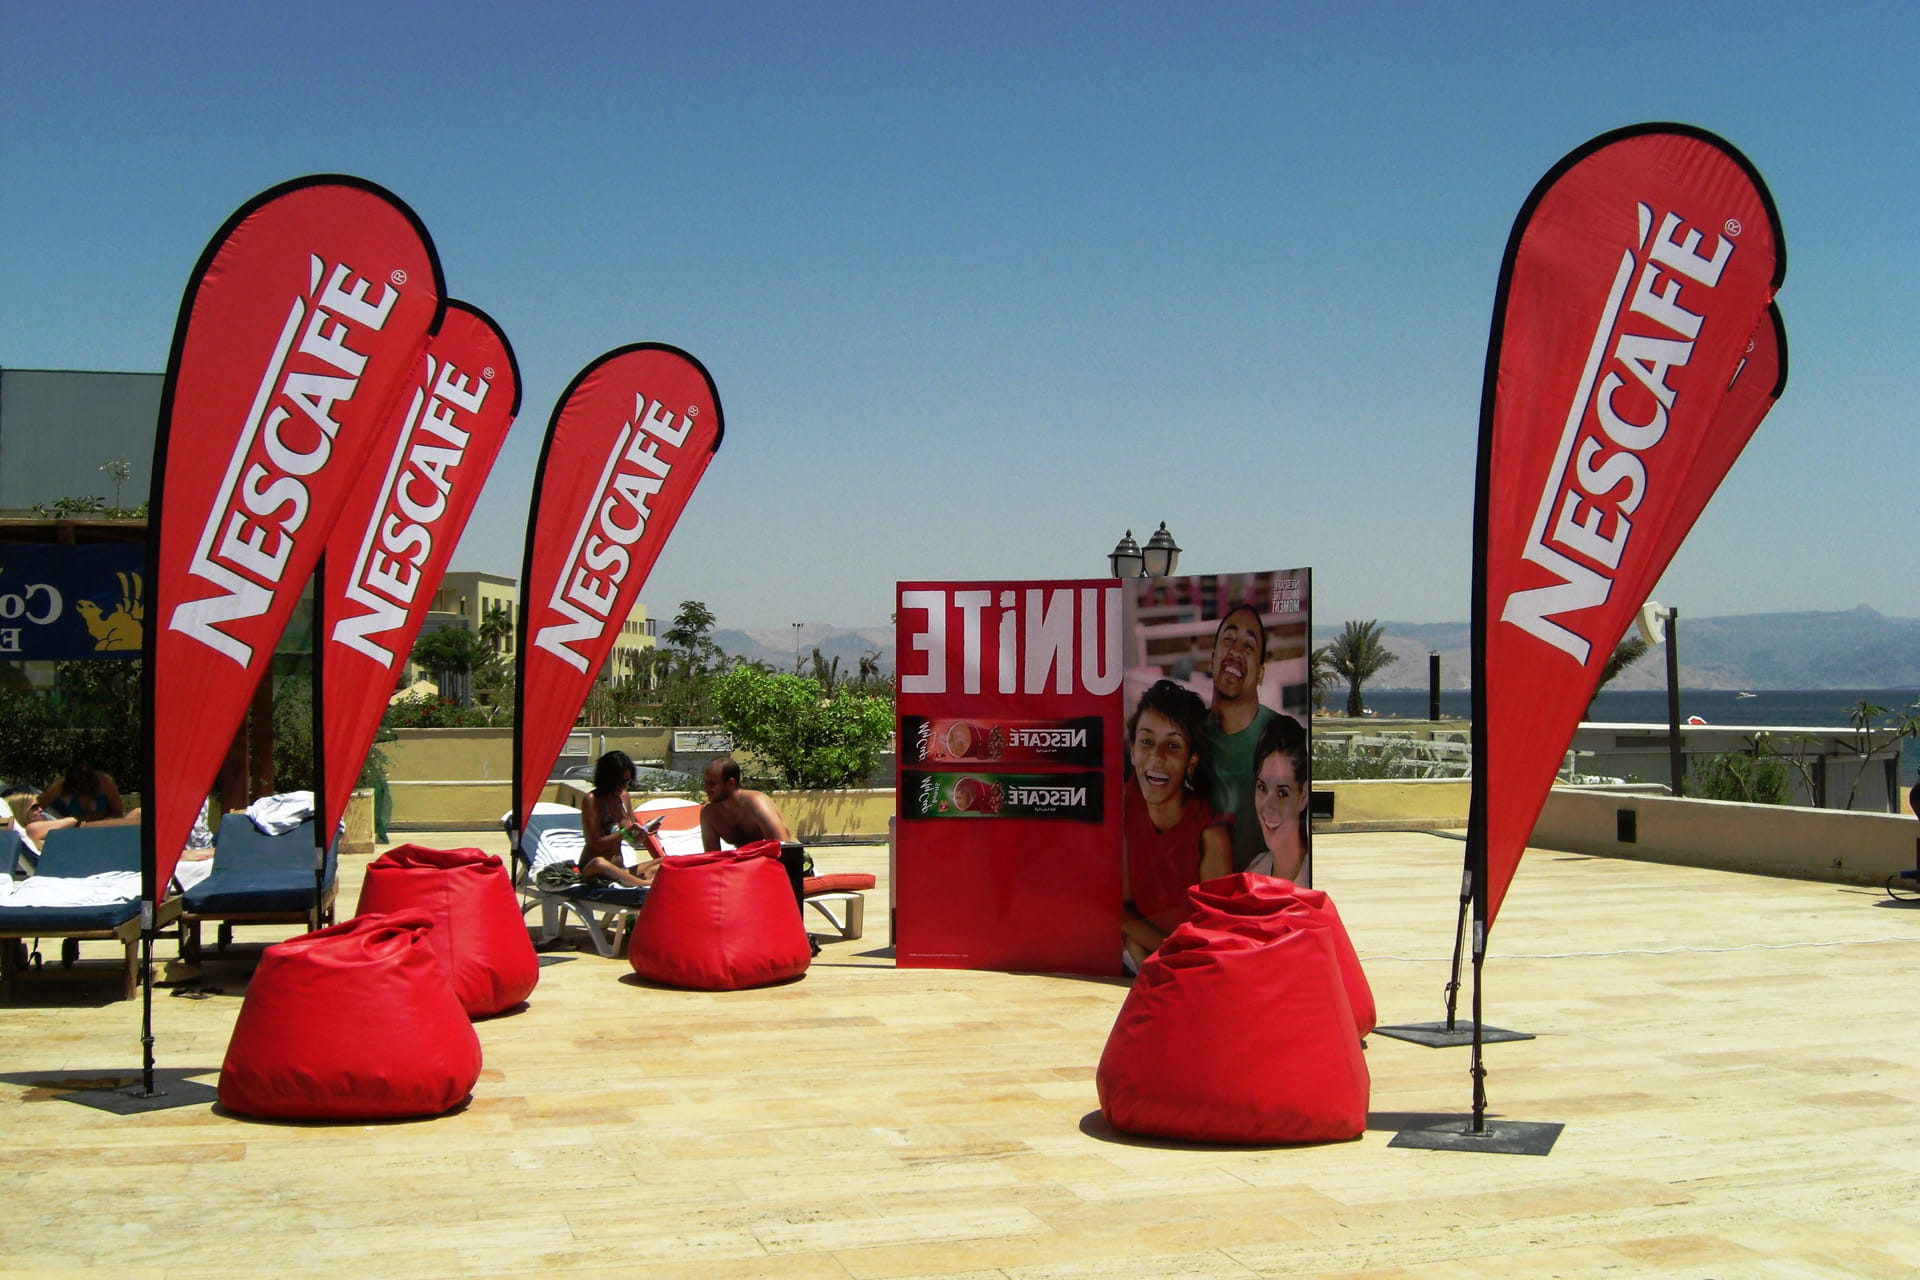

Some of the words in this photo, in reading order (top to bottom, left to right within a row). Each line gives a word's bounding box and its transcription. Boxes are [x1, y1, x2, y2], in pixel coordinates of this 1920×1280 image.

[168, 253, 399, 669] NESCAFÉ
[332, 353, 490, 669] NESCAFÉ
[534, 392, 693, 675] NESCAFÉ
[1500, 202, 1734, 667] NESCAFÉ
